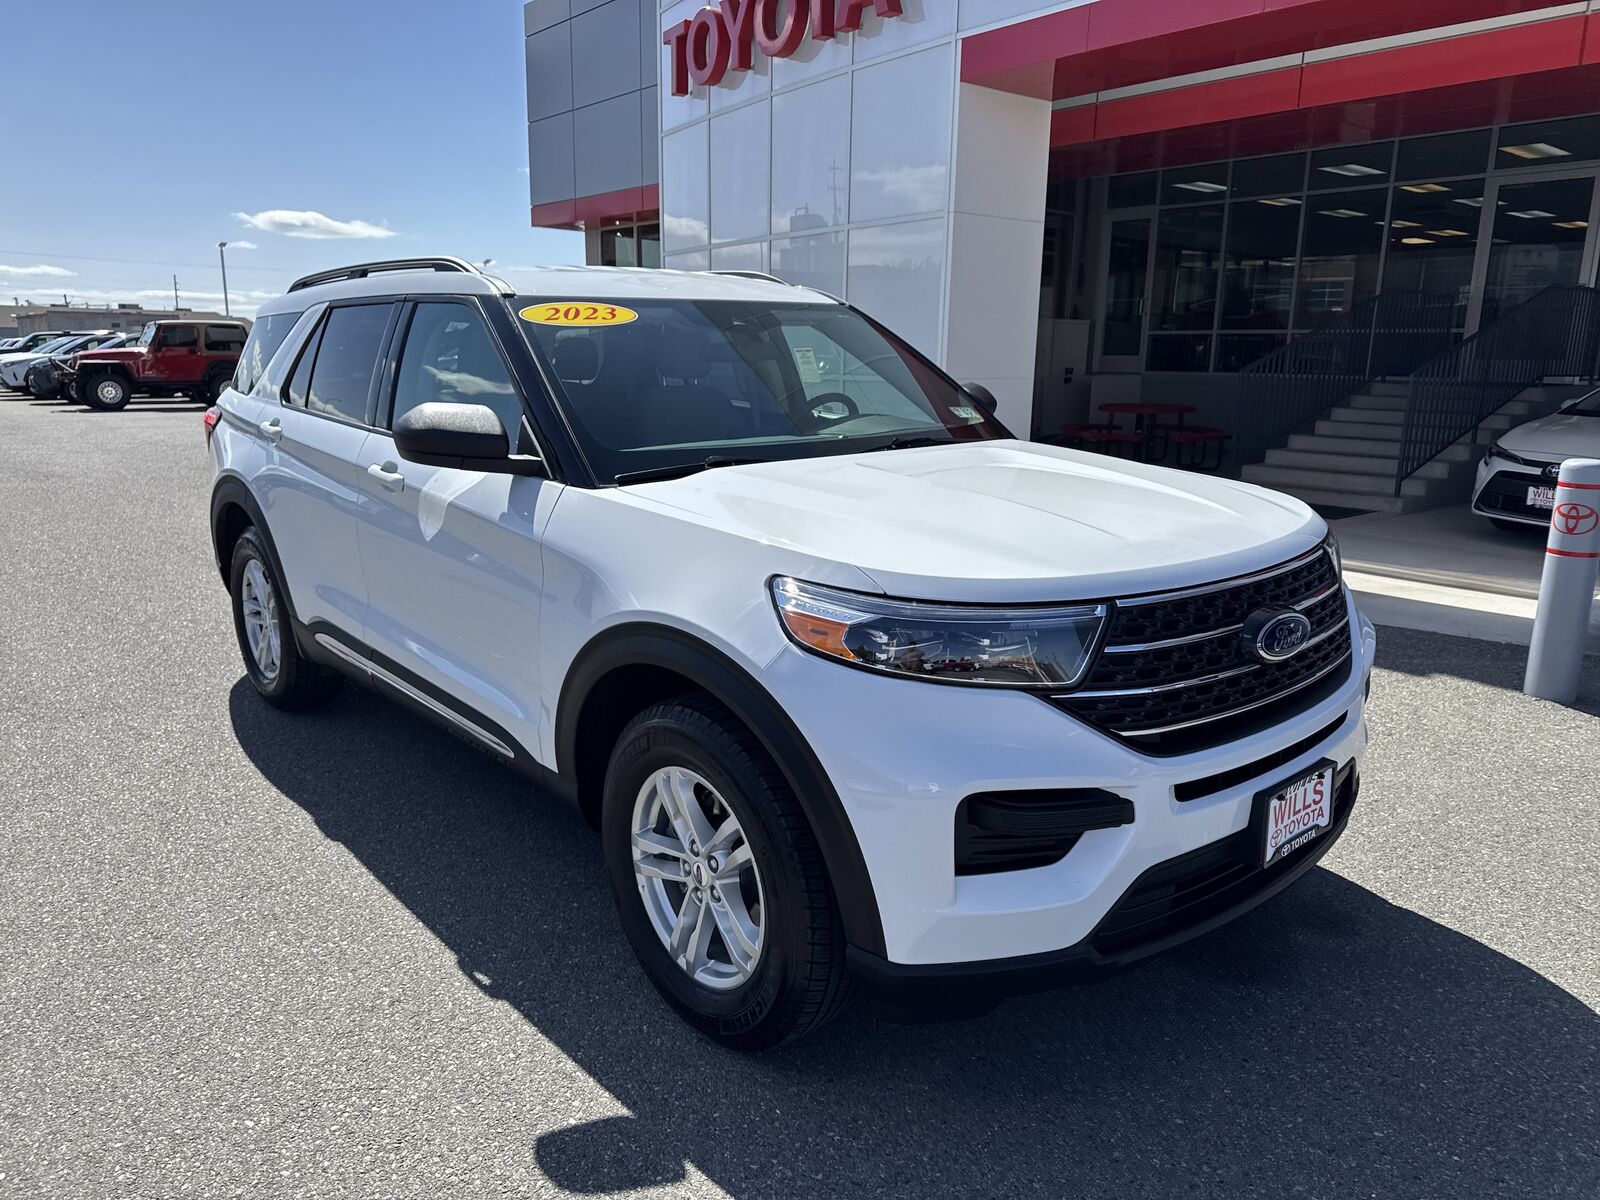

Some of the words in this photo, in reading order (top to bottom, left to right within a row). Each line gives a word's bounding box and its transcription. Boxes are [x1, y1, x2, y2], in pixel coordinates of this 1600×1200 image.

[663, 0, 903, 97] TOYO
[544, 306, 617, 321] 2023
[1533, 489, 1555, 500] WILL
[1274, 622, 1302, 652] Ford
[1273, 780, 1324, 829] WILLS
[1284, 806, 1325, 839] TOYOTA
[1291, 829, 1316, 849] TOYOTA
